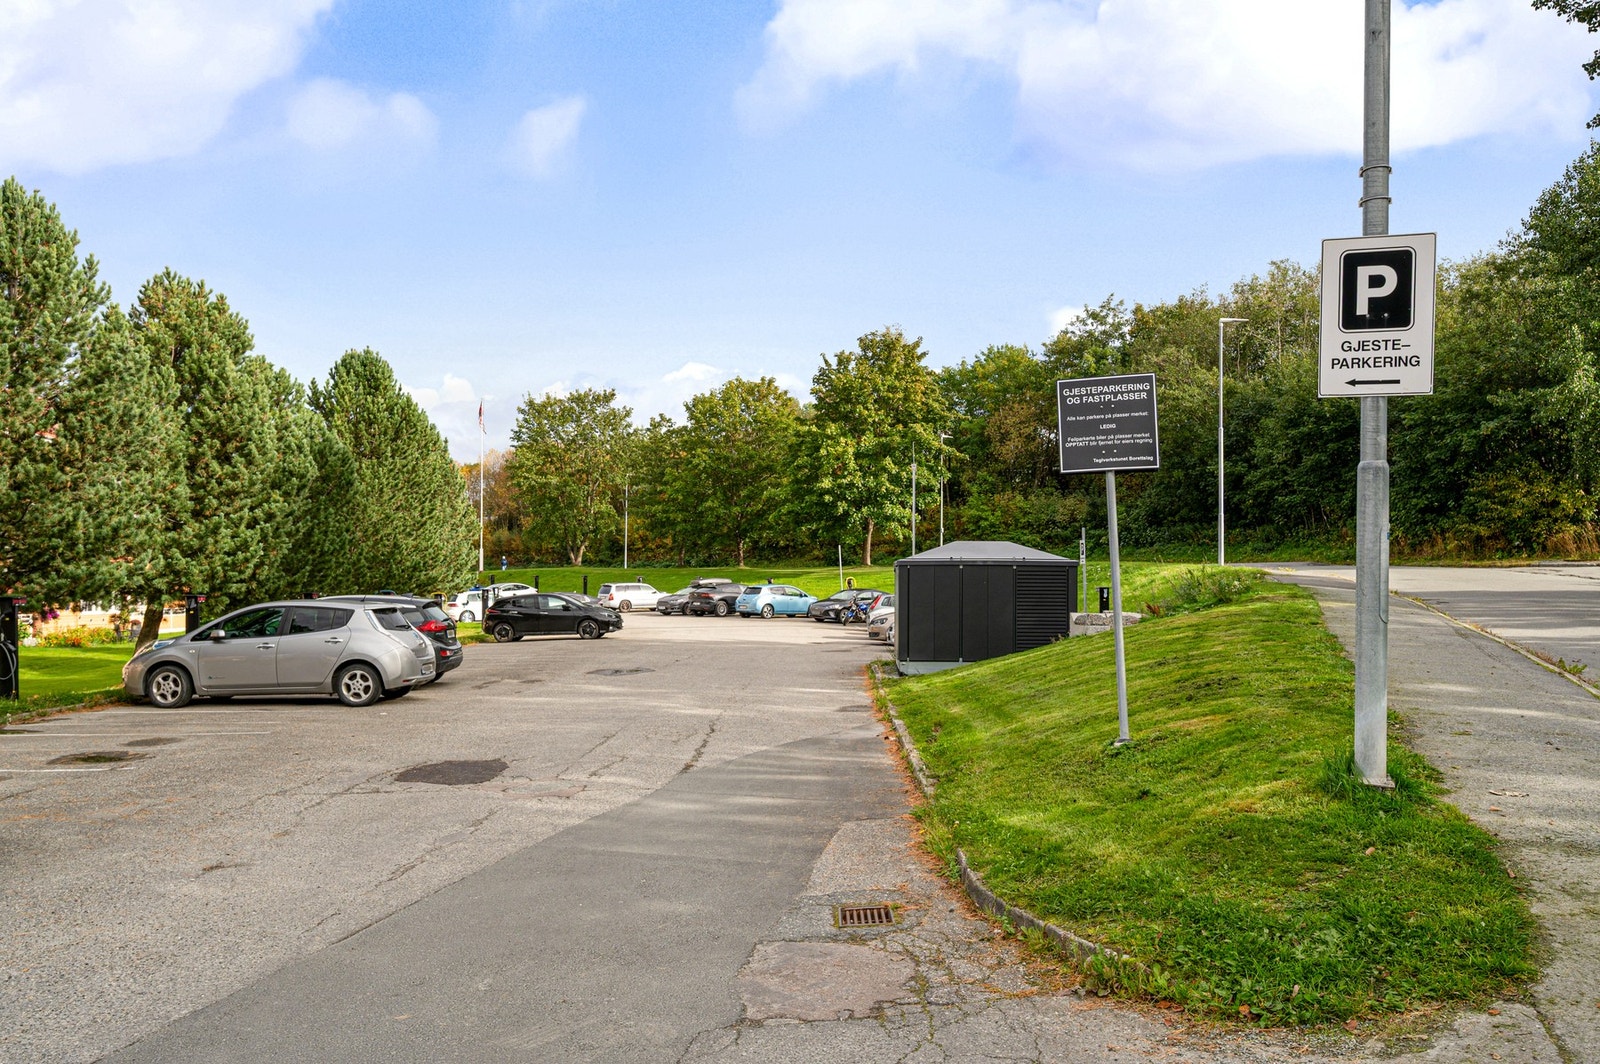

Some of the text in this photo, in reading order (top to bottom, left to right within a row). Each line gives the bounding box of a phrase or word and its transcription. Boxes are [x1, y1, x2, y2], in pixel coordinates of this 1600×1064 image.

[1356, 265, 1398, 316] P
[1331, 355, 1420, 370] PARKERING
[1063, 383, 1150, 396] GJESTEPARKERING
[1083, 392, 1147, 403] FASTPLASSER
